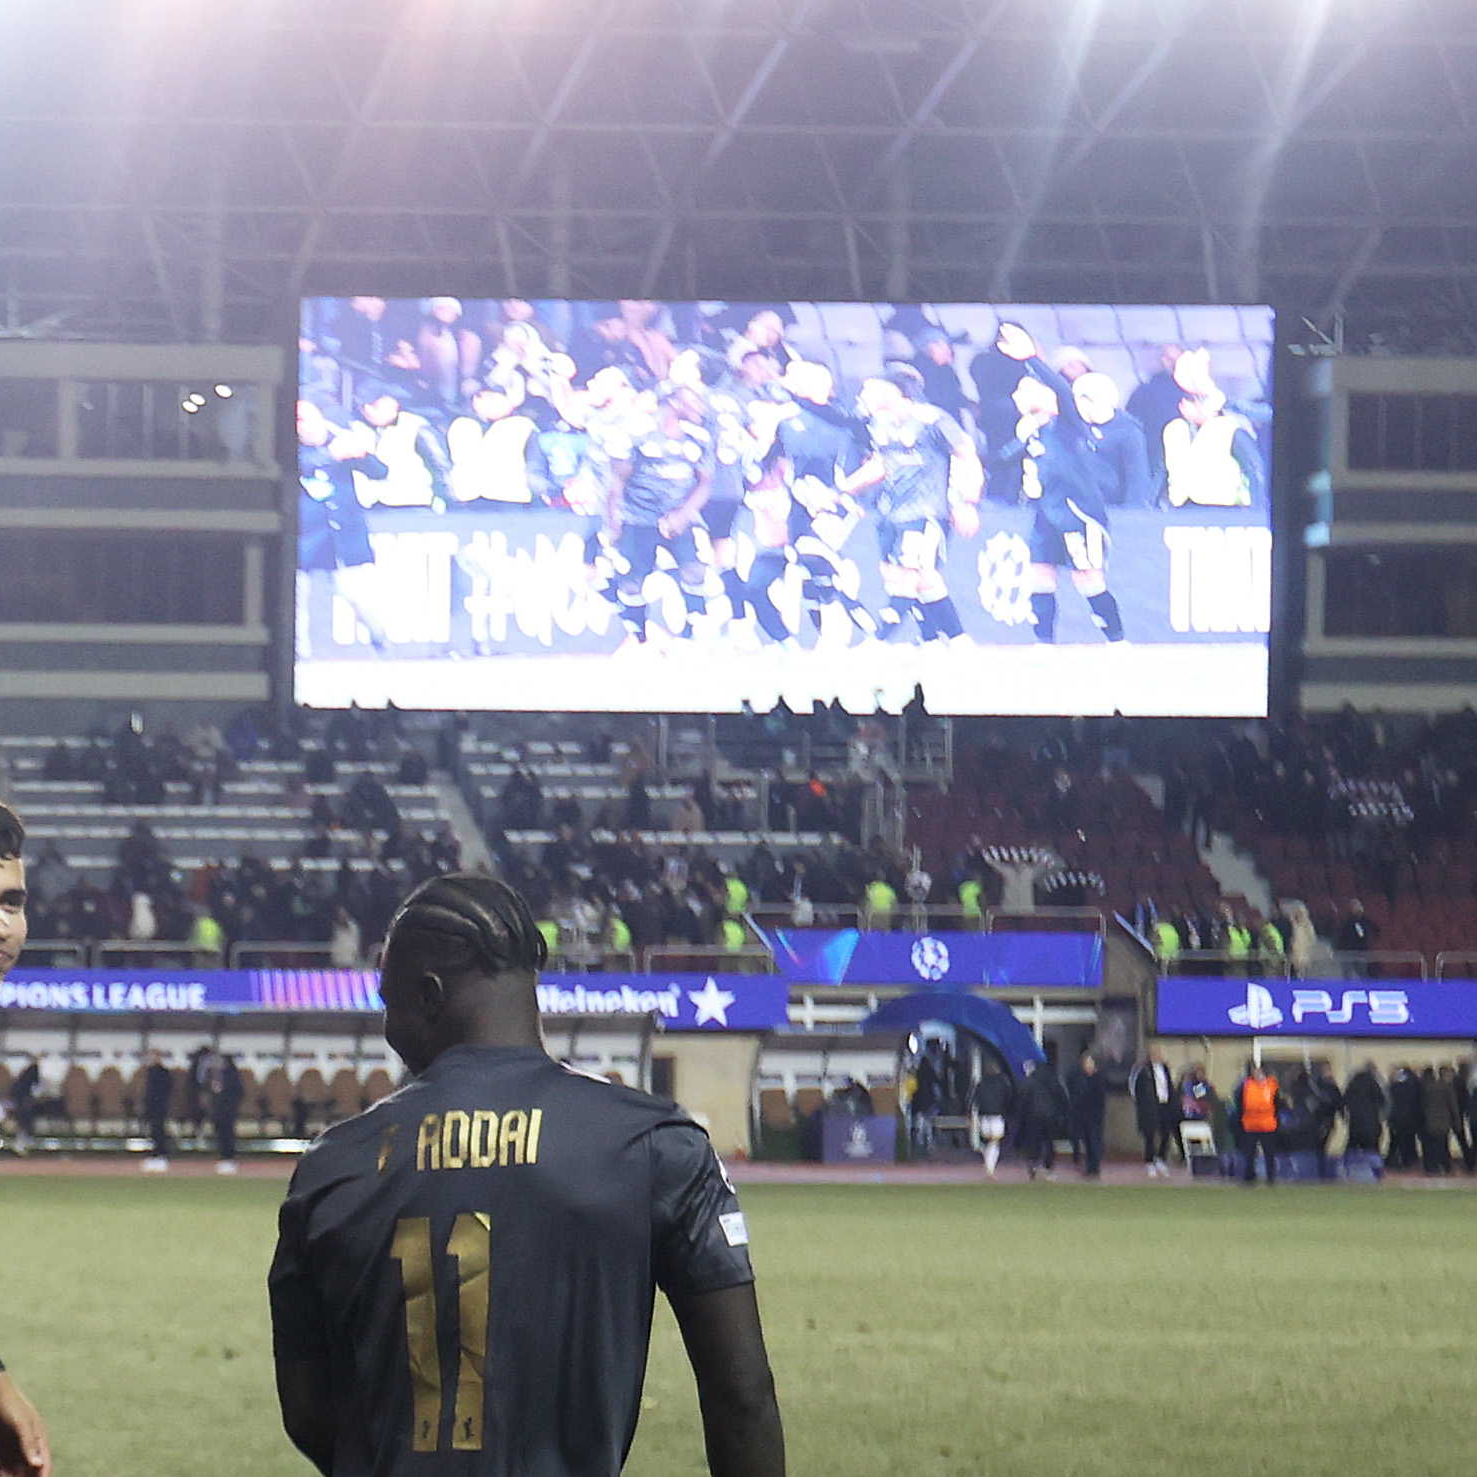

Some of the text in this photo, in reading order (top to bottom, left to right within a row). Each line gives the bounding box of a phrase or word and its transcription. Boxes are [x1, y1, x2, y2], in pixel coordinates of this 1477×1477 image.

[92, 981, 207, 1010] LEAGUE
[1292, 990, 1409, 1024] PS5
[416, 1109, 543, 1172] ADDAI
[390, 1211, 492, 1453] 11
